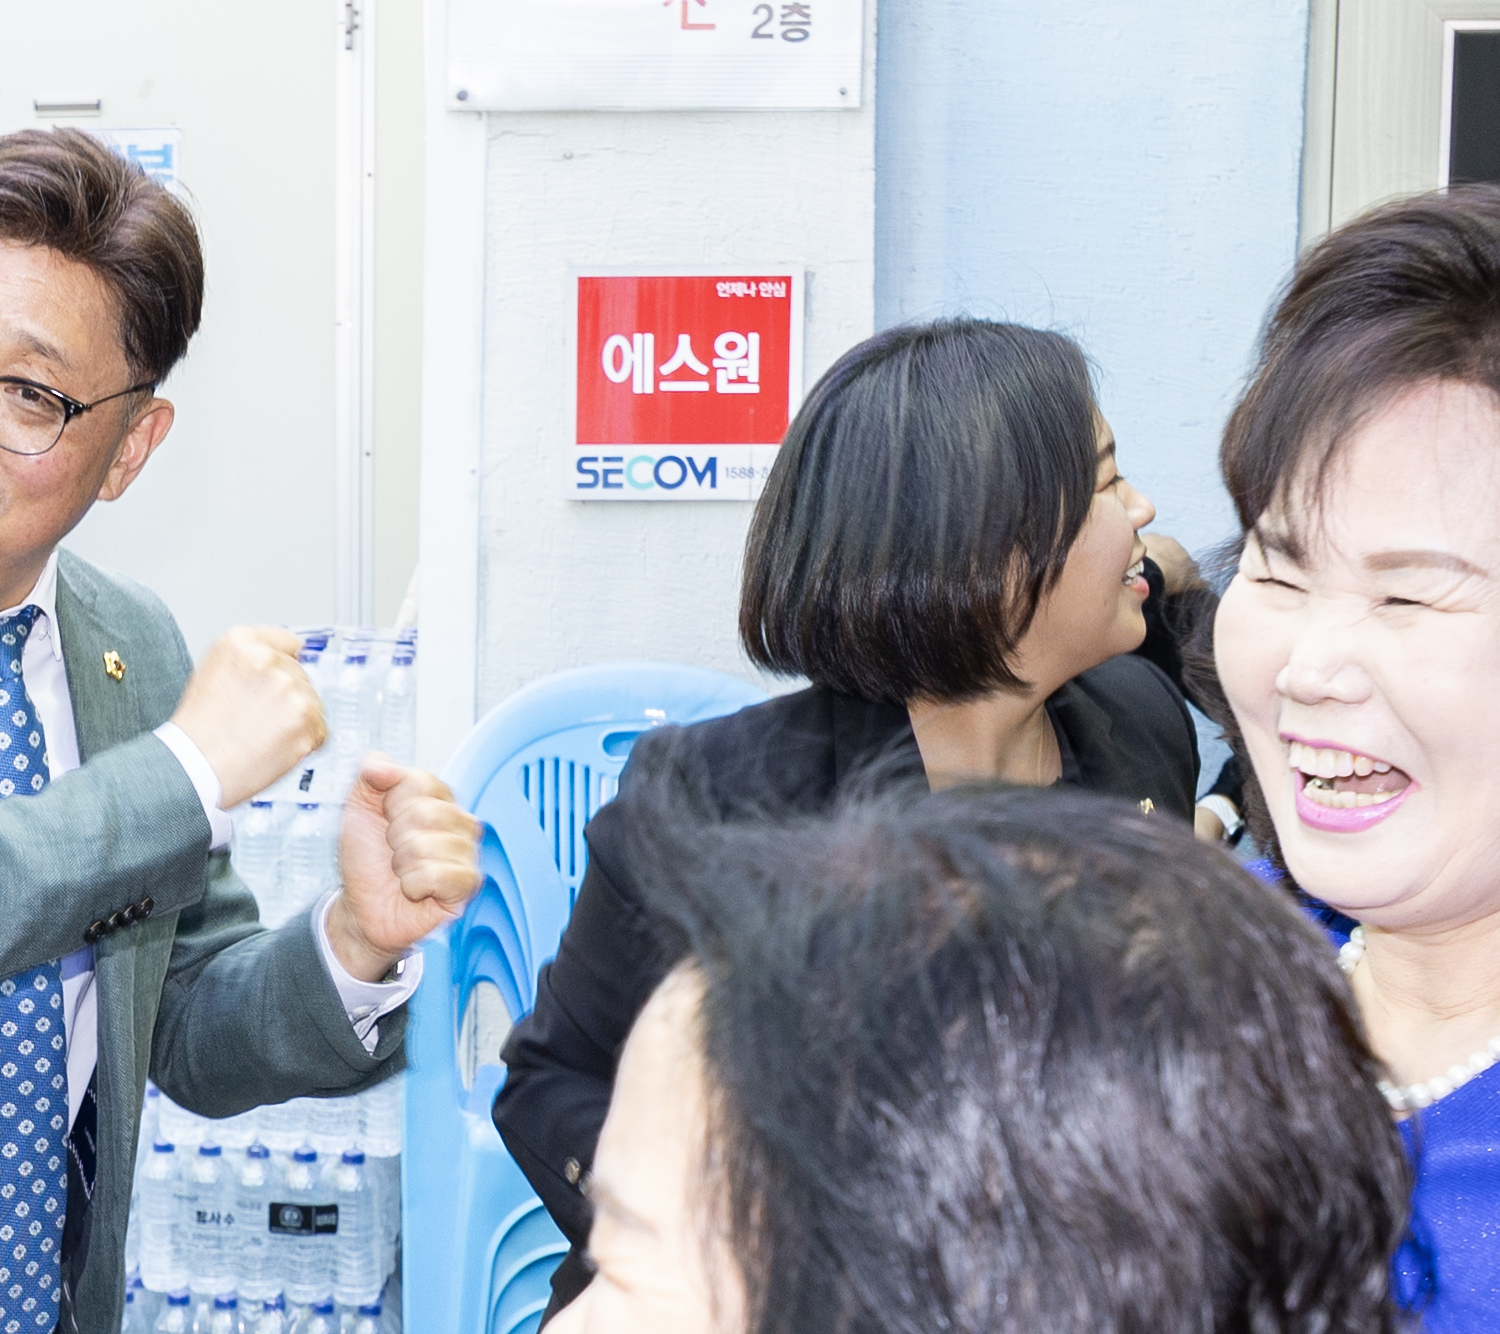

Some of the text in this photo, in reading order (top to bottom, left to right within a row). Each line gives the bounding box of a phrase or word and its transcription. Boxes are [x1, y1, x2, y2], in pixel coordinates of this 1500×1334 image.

[750, 2, 812, 43] 2층
[758, 281, 787, 298] 안심
[602, 331, 760, 395] 에스원
[576, 455, 717, 490] SECOM
